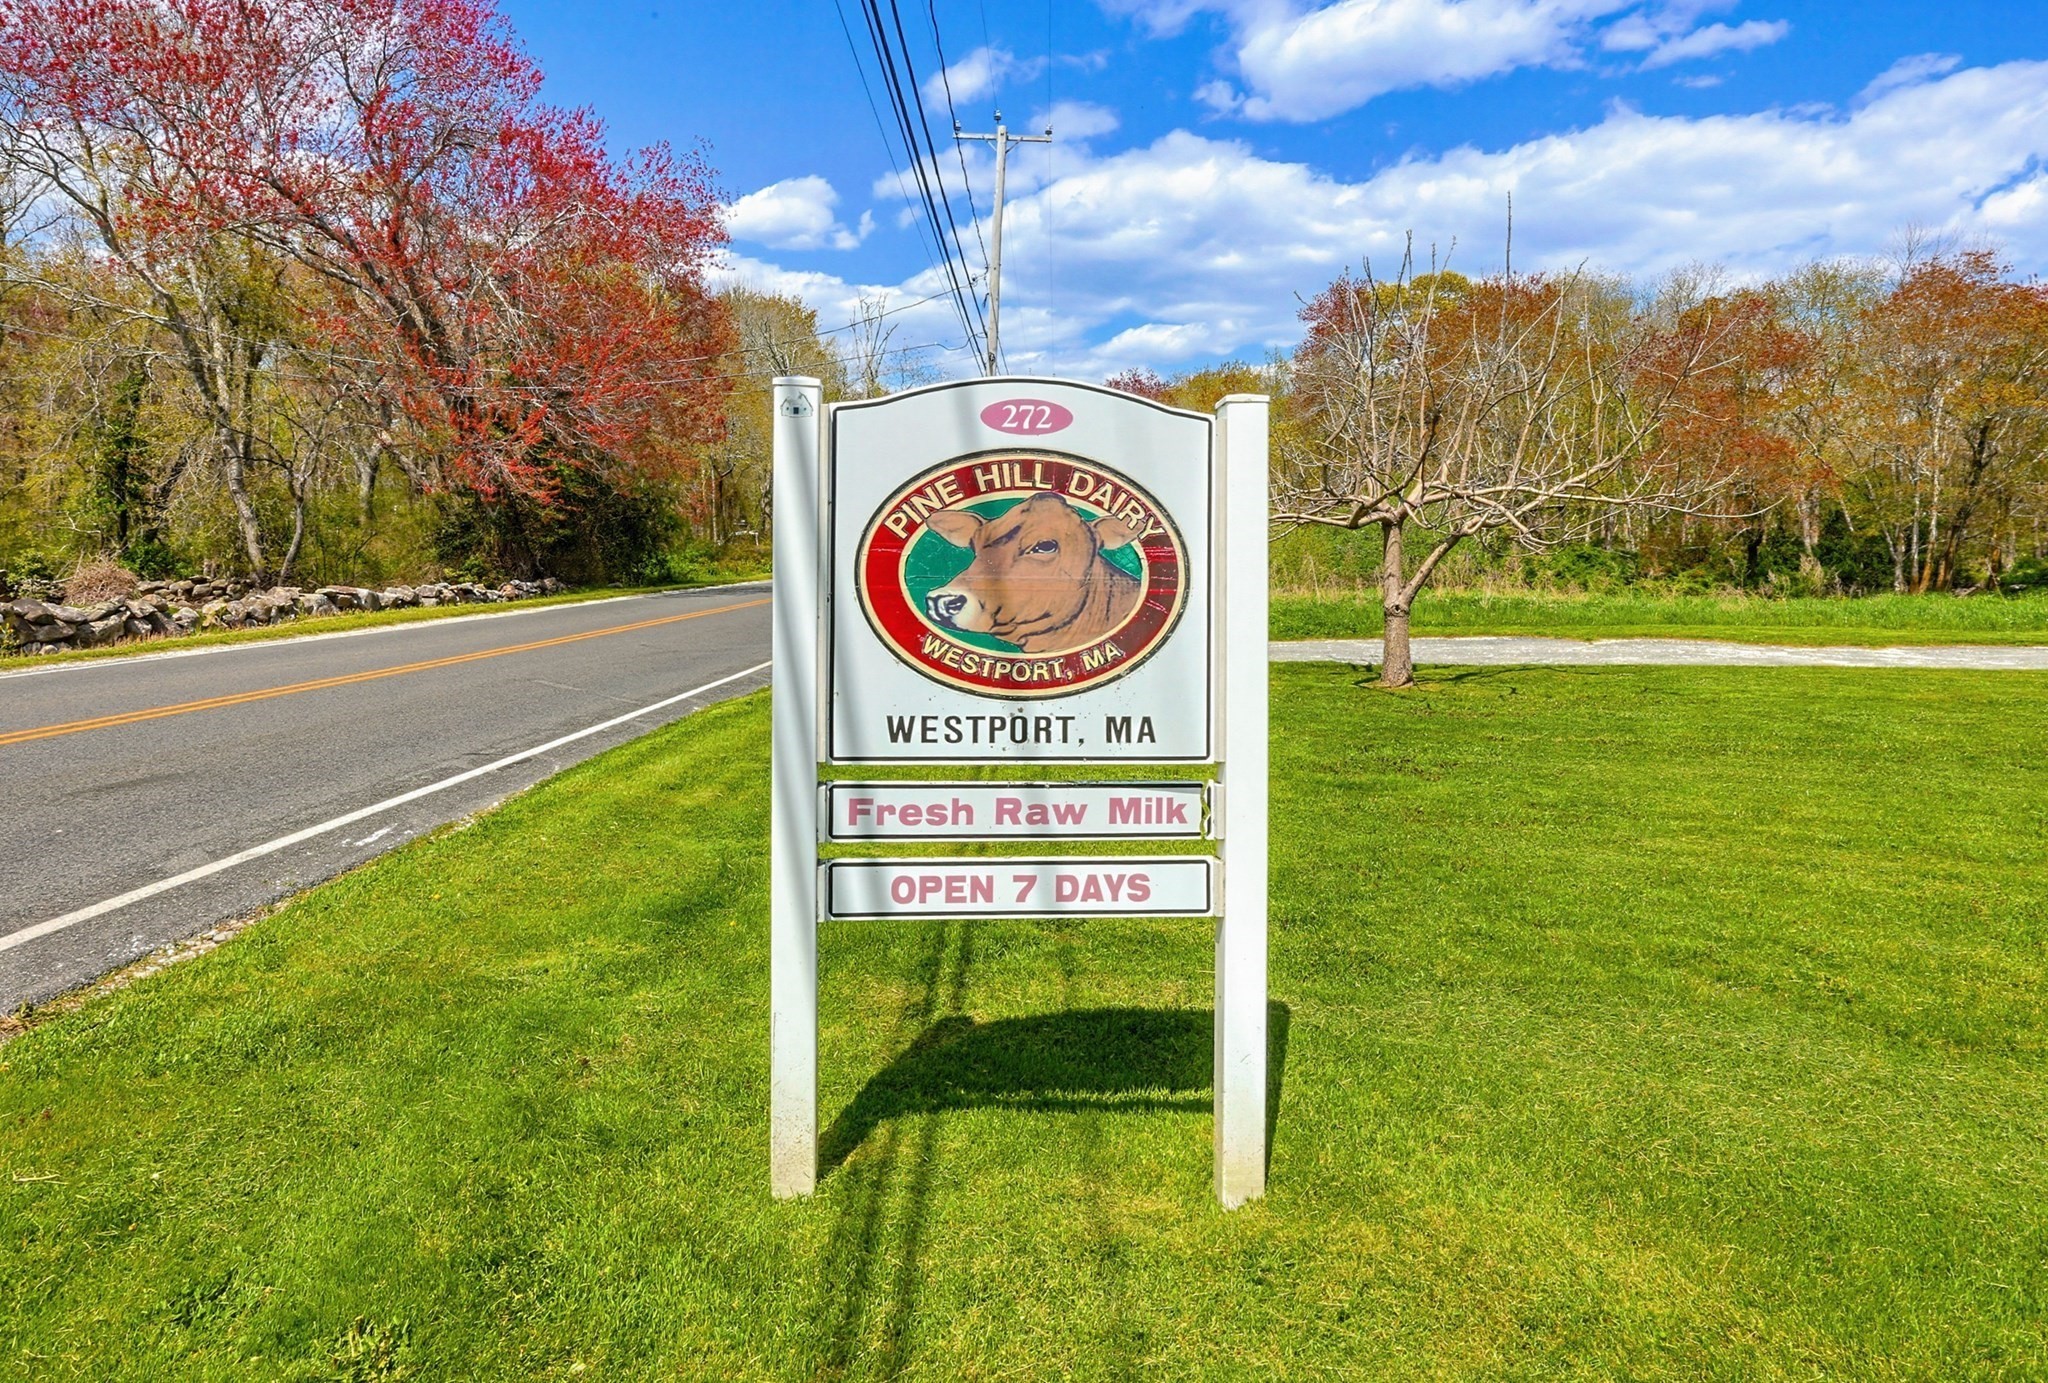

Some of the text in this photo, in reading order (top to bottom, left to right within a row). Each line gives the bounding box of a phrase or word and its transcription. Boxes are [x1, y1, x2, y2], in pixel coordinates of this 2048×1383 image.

[1001, 404, 1053, 429] 272
[884, 462, 1167, 541] PINE HILL DAIRY
[922, 634, 1123, 682] WESTPORT, MA
[886, 715, 1157, 747] WESTPORT, MA
[847, 797, 1188, 826] Fresh Raw Milk
[890, 873, 1151, 904] OPEN 7 DAYS
